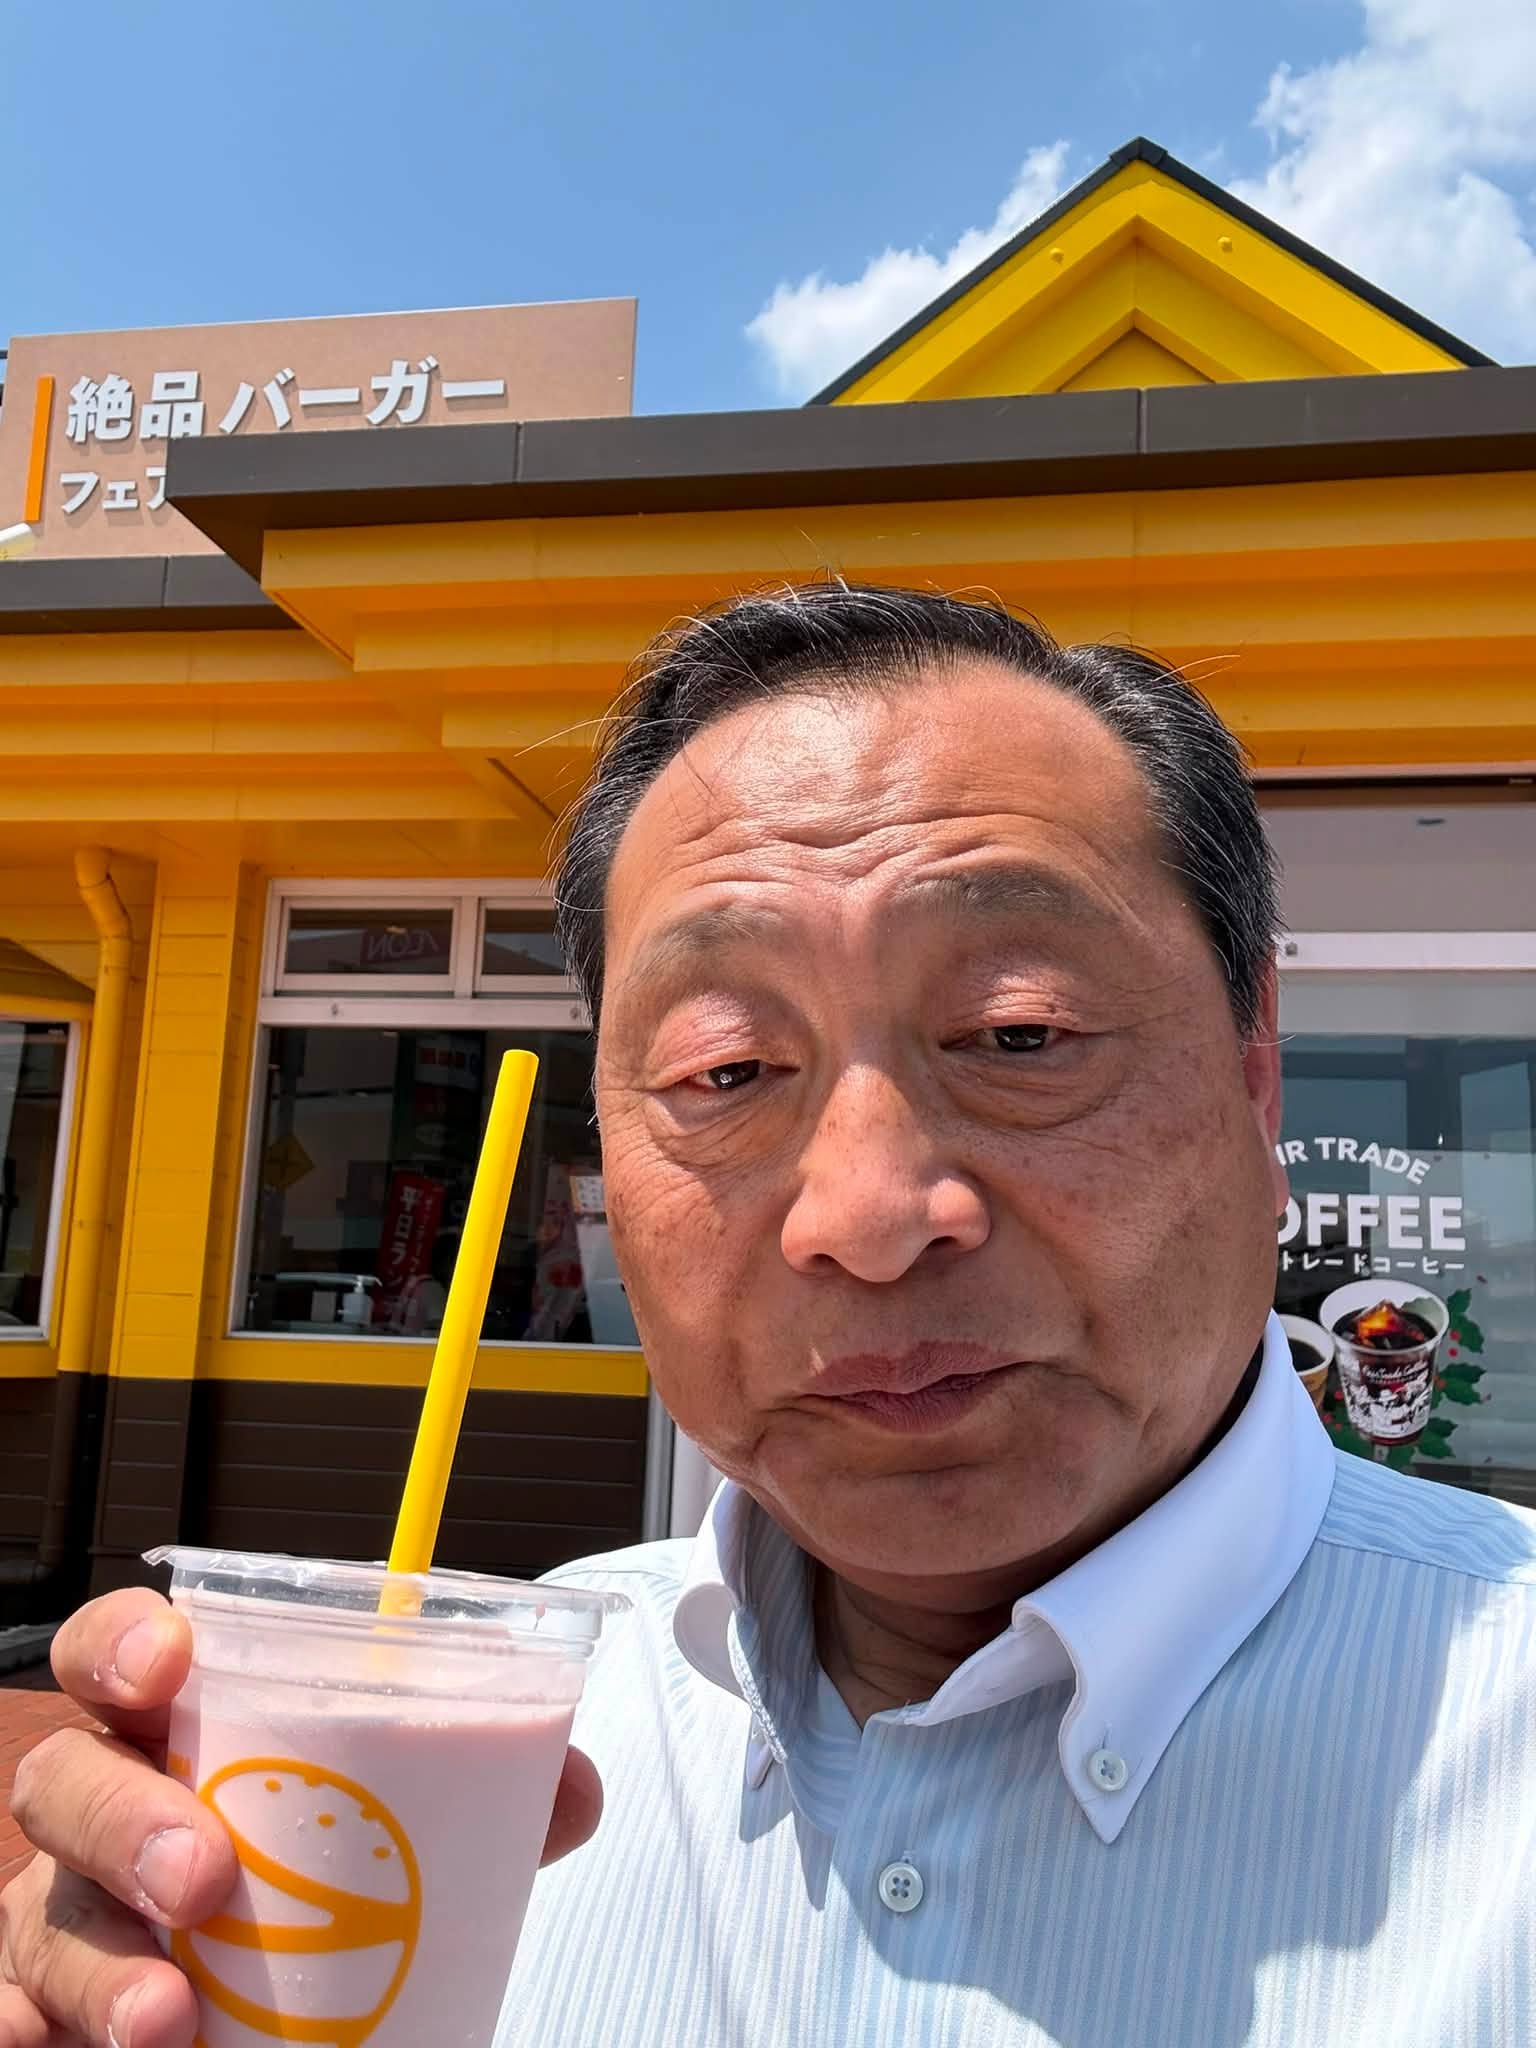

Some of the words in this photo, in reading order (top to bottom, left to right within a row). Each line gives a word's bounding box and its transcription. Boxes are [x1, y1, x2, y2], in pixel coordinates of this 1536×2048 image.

[1314, 1136, 1431, 1186] TRADE
[1281, 1250, 1465, 1275] トレードコーヒー
